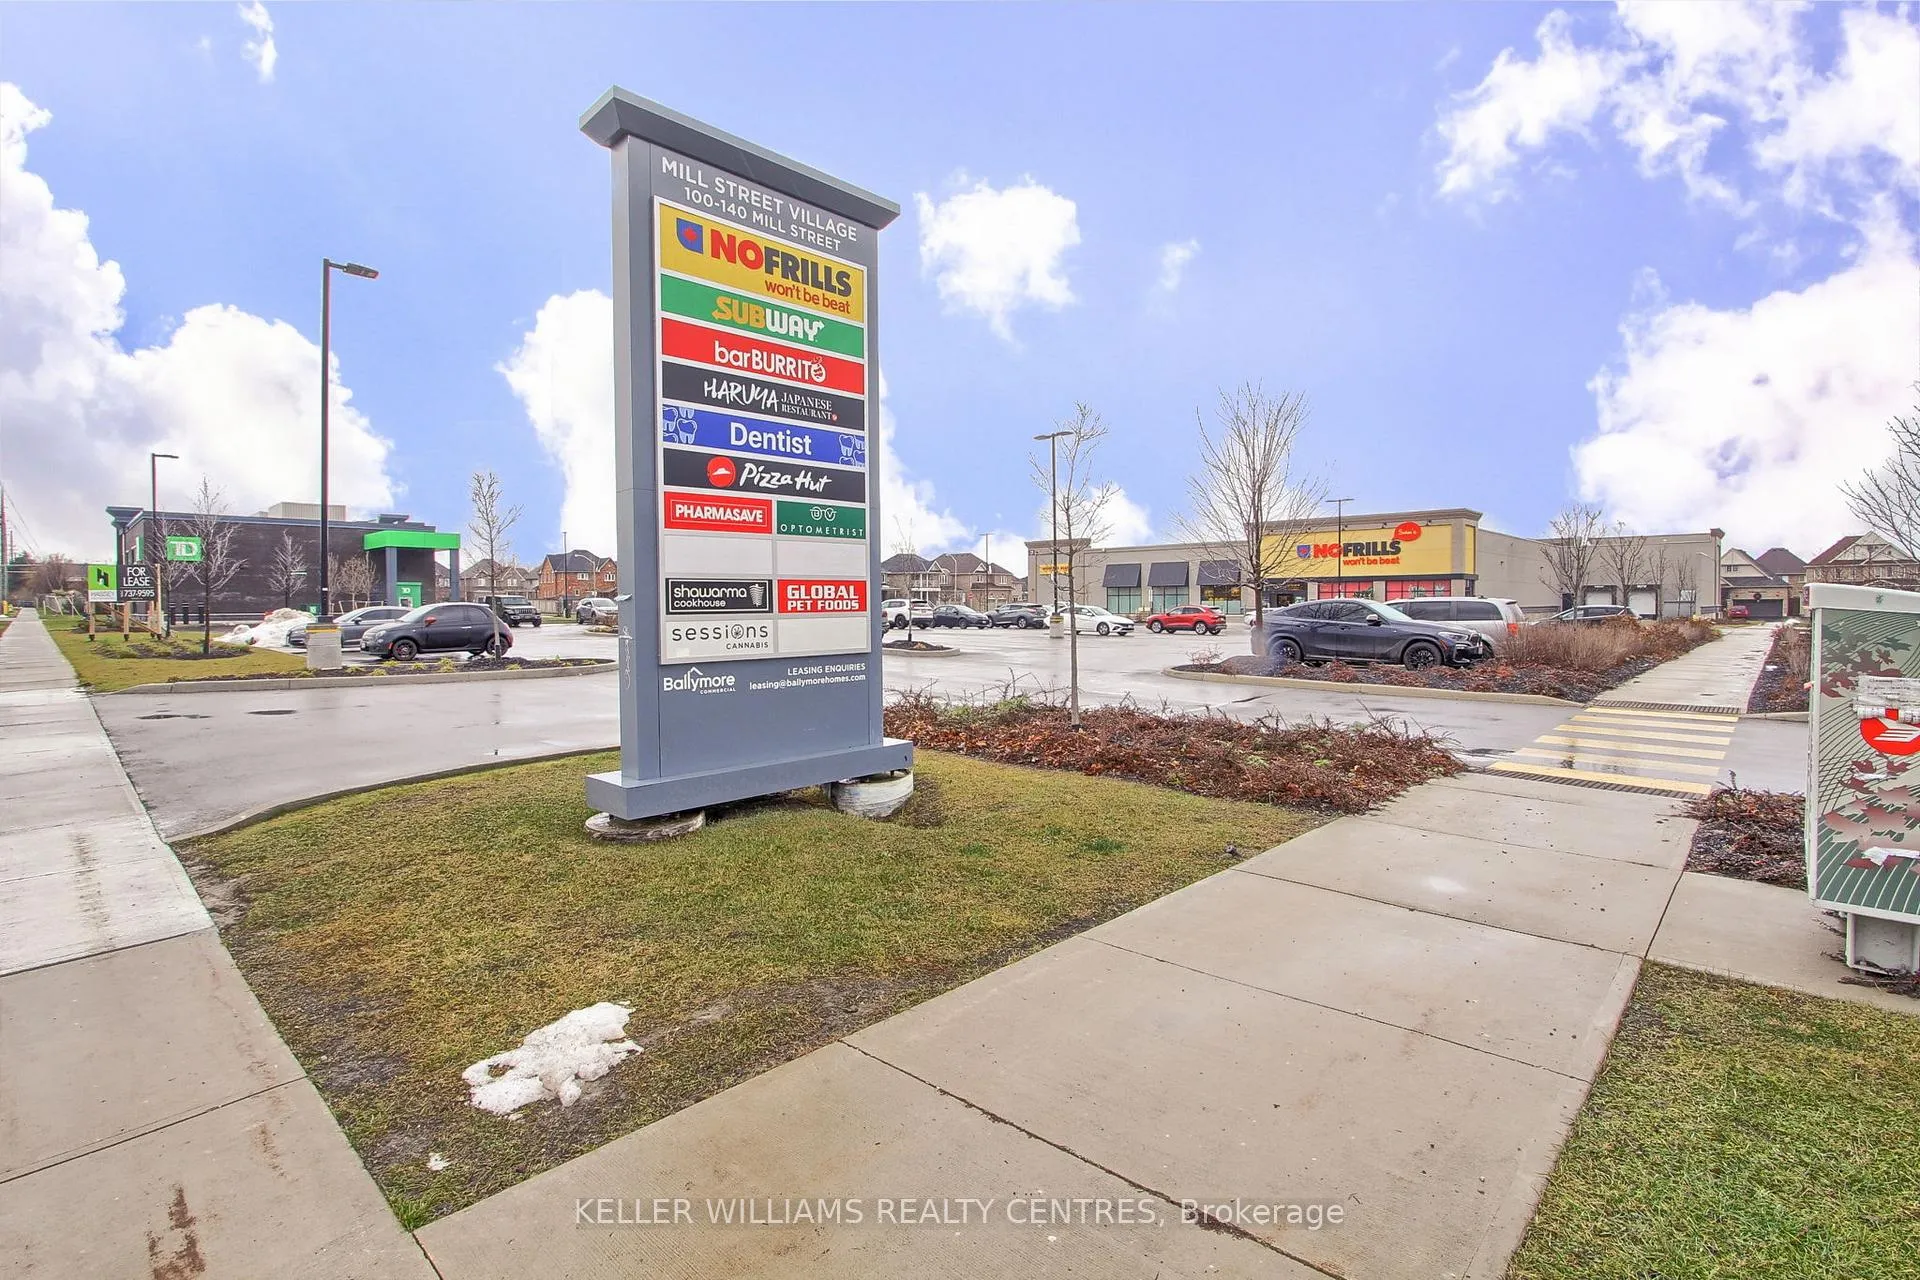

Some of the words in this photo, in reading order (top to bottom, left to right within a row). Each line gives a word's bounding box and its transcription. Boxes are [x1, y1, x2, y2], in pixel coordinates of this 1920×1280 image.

[661, 156, 709, 189] MILL
[714, 176, 783, 214] STREET
[788, 203, 857, 242] VILLAGE
[684, 186, 747, 219] 100-140
[752, 210, 786, 233] MILL
[790, 224, 841, 251] STREET
[764, 280, 802, 302] won't
[803, 289, 821, 306] be
[822, 295, 851, 315] beat
[711, 296, 825, 343] SUBWAY
[703, 377, 778, 412] HARUYA
[781, 392, 833, 411] JAPANESE
[781, 404, 832, 421] RESTAURANT
[730, 421, 812, 456] Dentist
[739, 462, 793, 487] Pizza
[793, 469, 833, 493] Hut
[675, 503, 763, 523] PHARMASAVE
[780, 523, 864, 537] OPTOMETRIST
[170, 541, 197, 557] TD
[126, 567, 146, 577] FOR
[123, 576, 151, 587] LEASE
[673, 584, 747, 599] shawarma
[786, 584, 859, 600] GLOBAL
[673, 598, 726, 608] cookhouse
[787, 601, 812, 611] PET
[817, 599, 859, 611] FOODS
[671, 624, 769, 642] sessions
[725, 641, 769, 650] CANNABIS
[787, 666, 822, 677] LEASING
[824, 662, 866, 674] ENQUIRIES
[663, 669, 736, 694] Ballymore
[749, 673, 866, 691] leasing@ballymorehomes.com
[699, 686, 736, 695] COMMERCIAL
